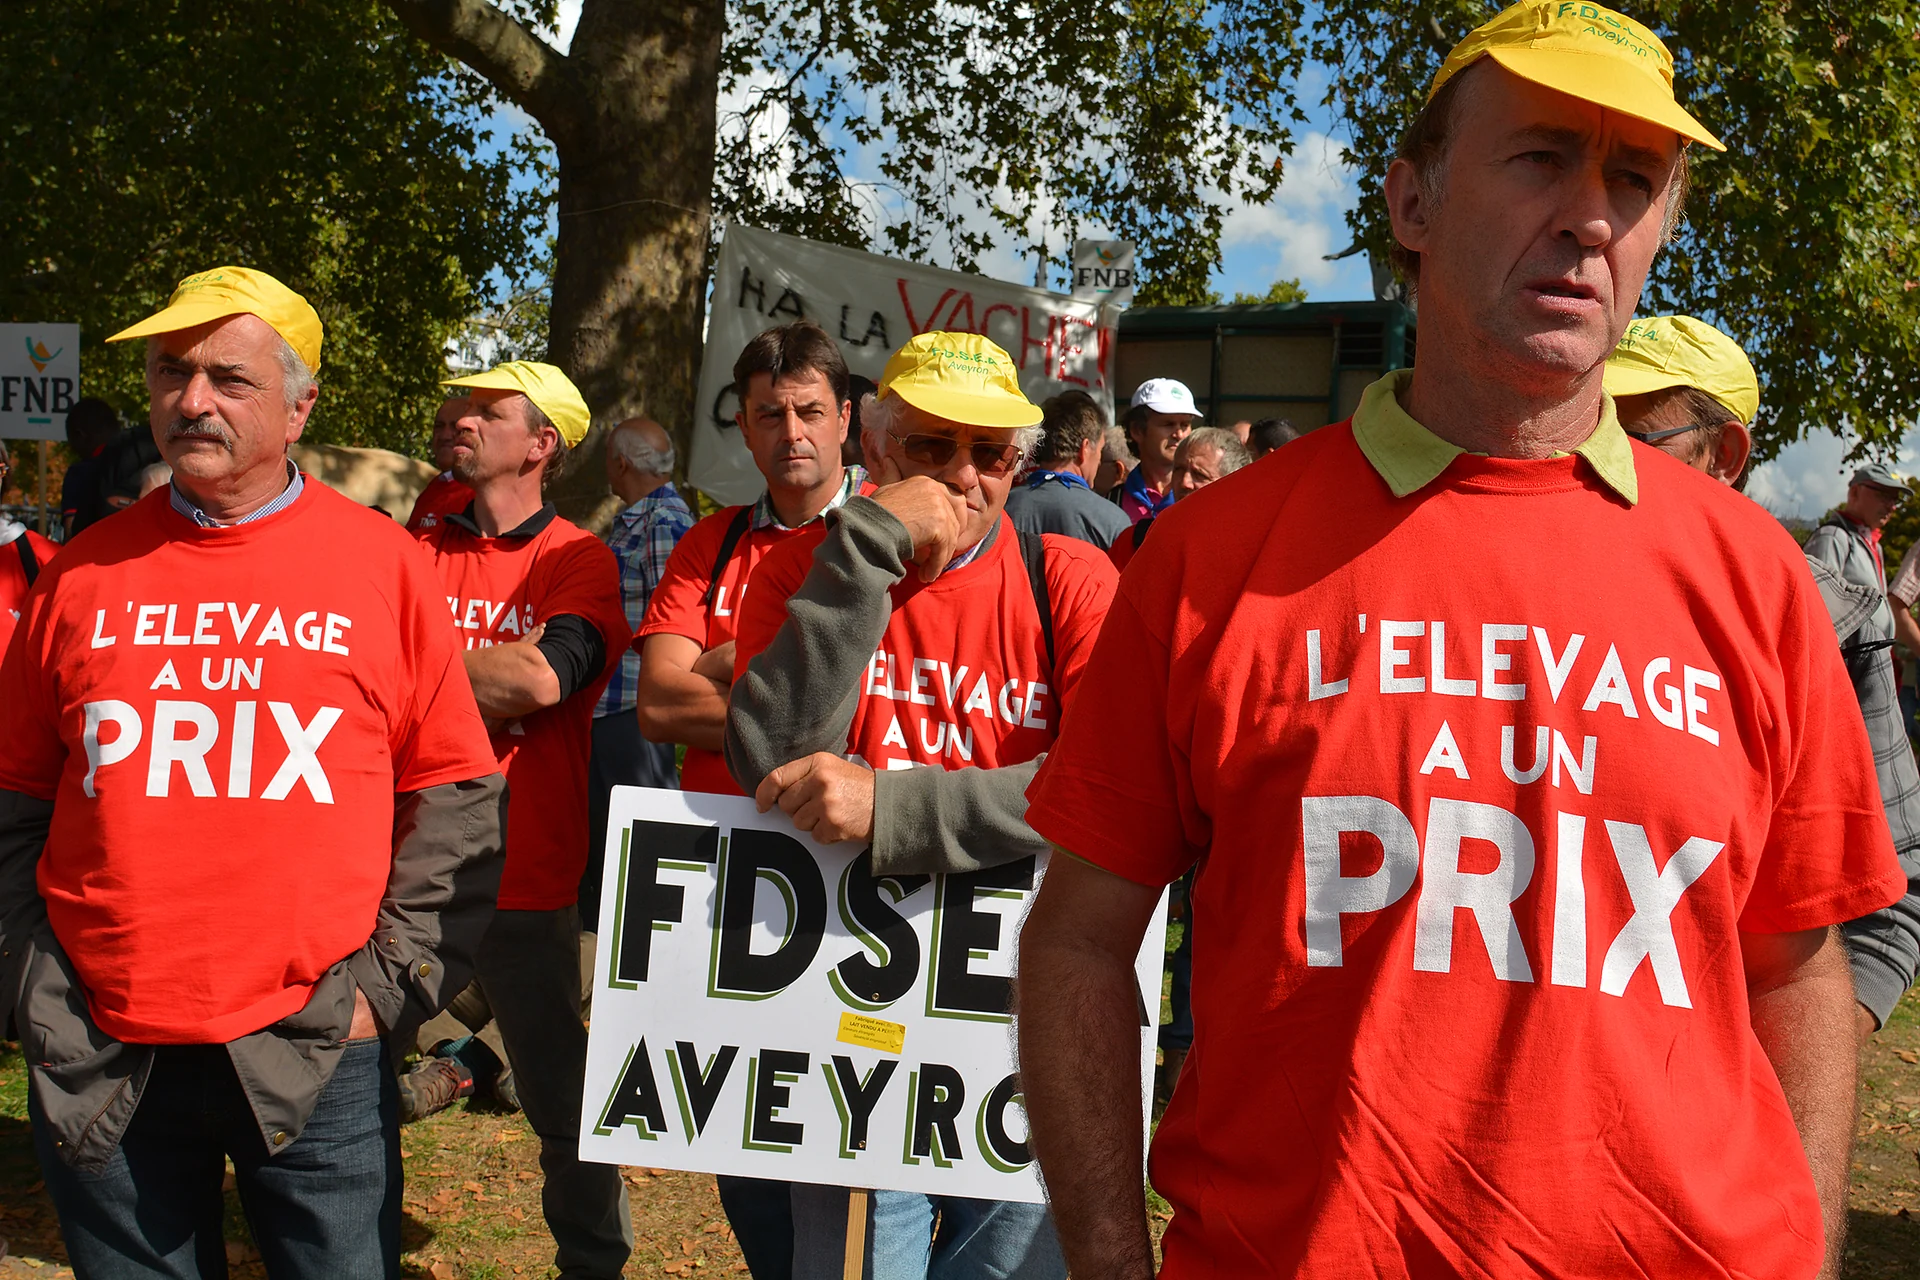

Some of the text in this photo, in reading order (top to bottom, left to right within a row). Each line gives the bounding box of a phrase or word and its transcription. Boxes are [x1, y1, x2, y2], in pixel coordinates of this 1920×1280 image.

[1583, 26, 1648, 57] Aveyron
[1078, 267, 1131, 288] FNB
[739, 266, 1109, 388] HA LA VACHE!
[1, 376, 74, 413] FNB
[948, 361, 989, 375] Aveyron
[91, 602, 352, 656] L'ELEVAGE
[150, 657, 263, 692] A UN
[866, 650, 1048, 730] ELEVAGE
[1306, 614, 1721, 747] L'ELEVAGE
[83, 700, 344, 805] PRIX
[881, 714, 973, 761] A UN
[1419, 720, 1597, 795] A UN
[608, 819, 1150, 1027] FDSE
[1301, 795, 1725, 1009] PRIX
